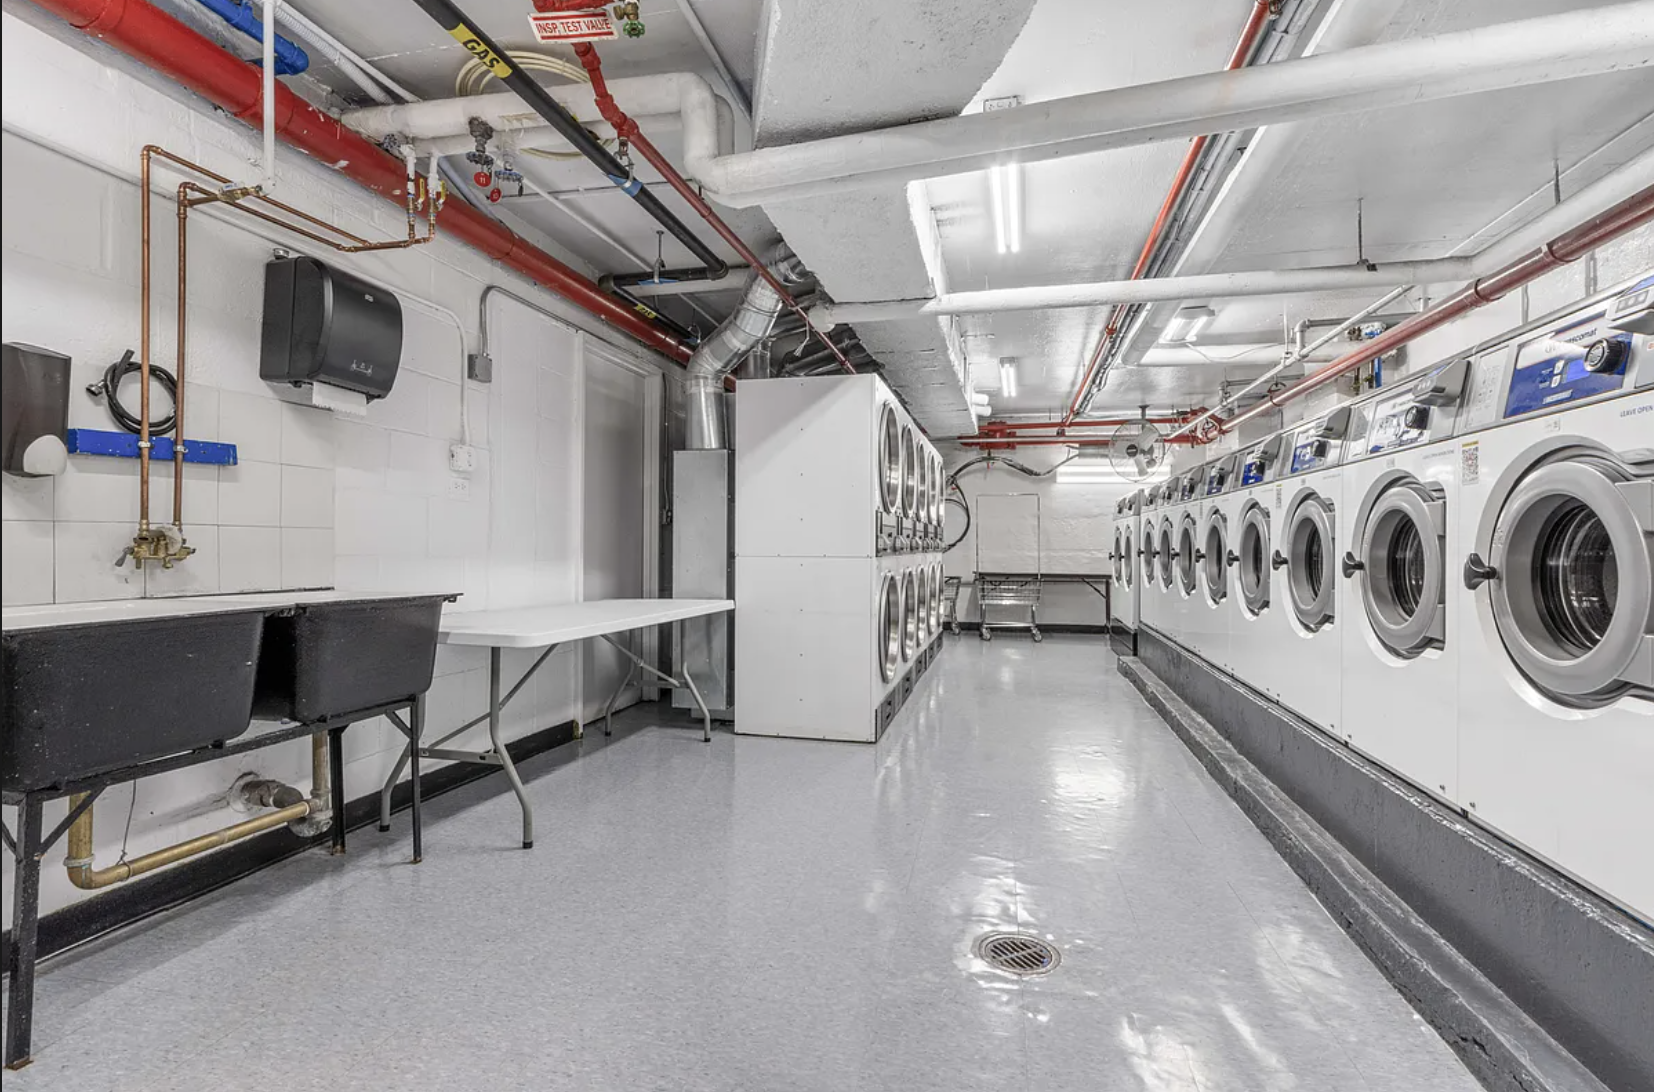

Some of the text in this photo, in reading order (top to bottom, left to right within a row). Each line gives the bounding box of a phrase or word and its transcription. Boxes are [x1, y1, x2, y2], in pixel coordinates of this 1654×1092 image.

[535, 18, 612, 34] INSP. TEST VALVE
[462, 38, 500, 68] GAS
[1637, 404, 1654, 415] OPEN
